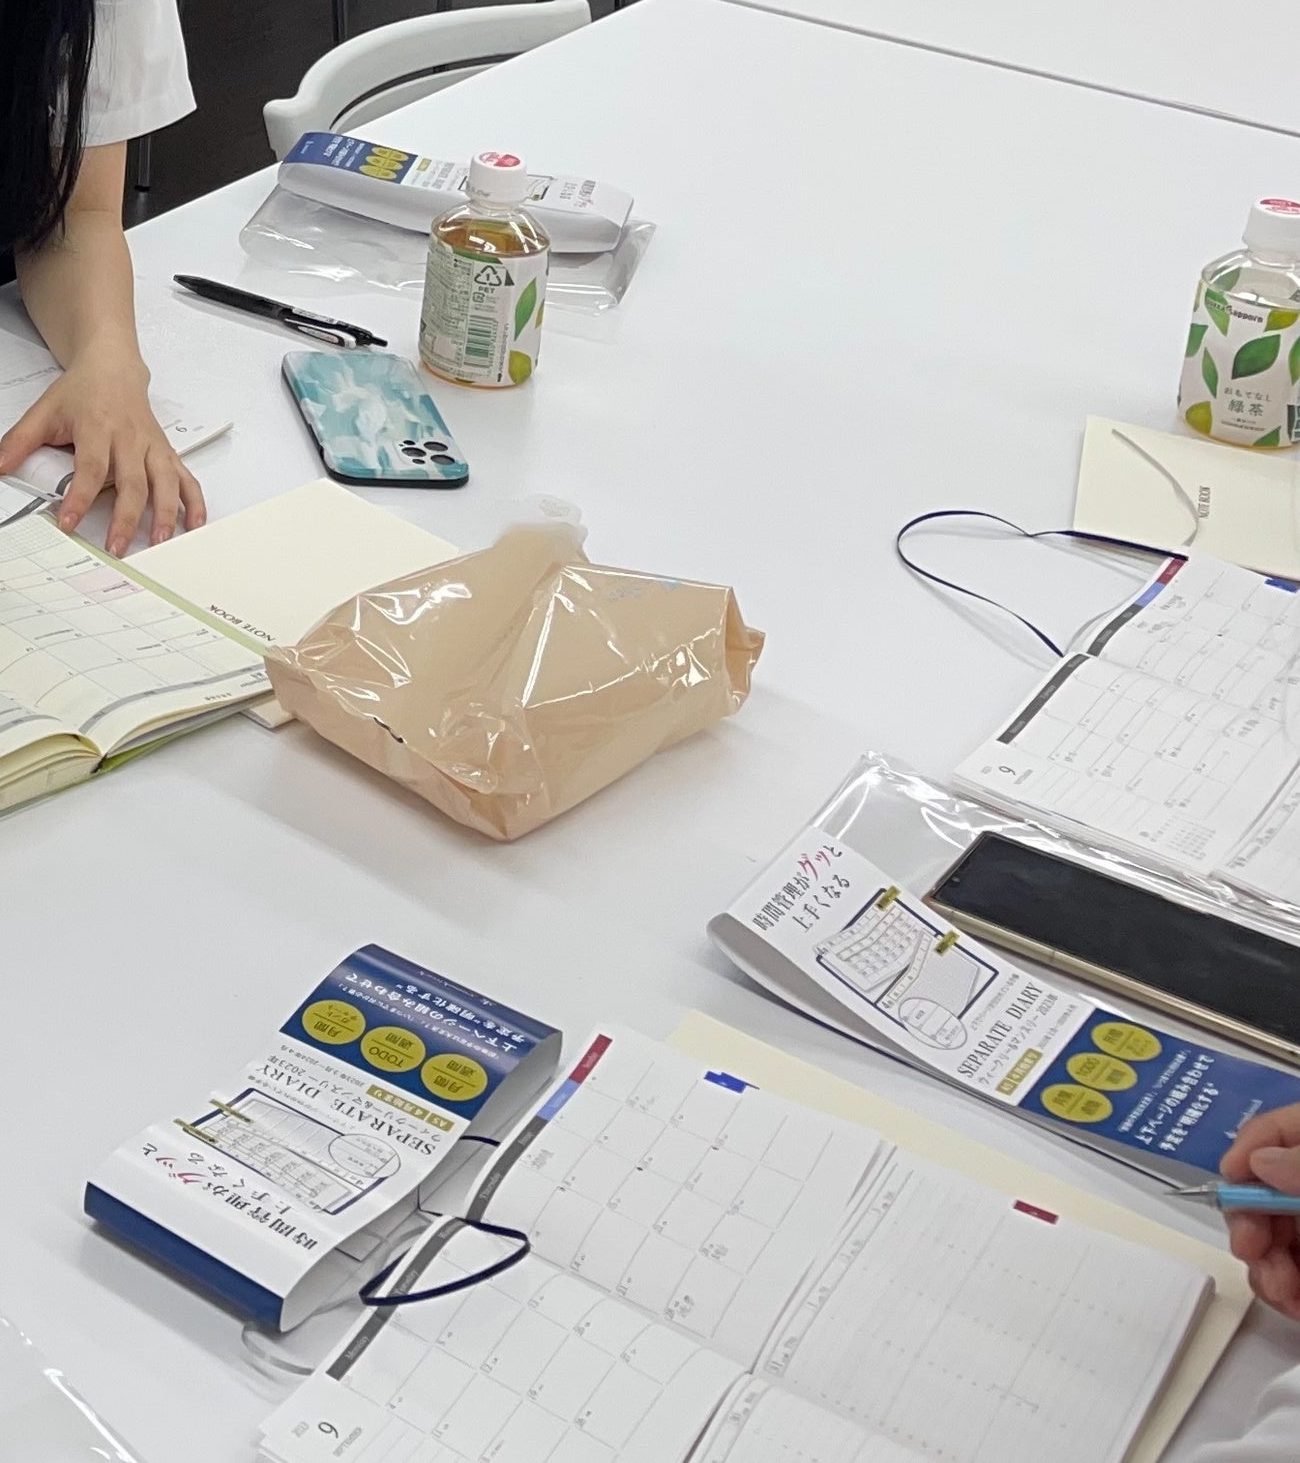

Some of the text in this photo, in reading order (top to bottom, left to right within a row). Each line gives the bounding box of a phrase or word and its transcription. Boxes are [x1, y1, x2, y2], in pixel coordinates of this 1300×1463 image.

[1228, 399, 1264, 416] 緑茶
[209, 604, 275, 641] NOTE BOOK
[793, 875, 851, 933] 上手くなる
[313, 1020, 342, 1038] 月間
[957, 1022, 1013, 1078] SEPARATE
[1005, 982, 1043, 1023] DIARY
[369, 1045, 404, 1068] TODO
[259, 1063, 319, 1098] DIARY
[432, 1075, 460, 1094] 月間
[331, 1098, 437, 1156] SEPARATE
[142, 1142, 318, 1251] 時間管理がグッと
[317, 1420, 339, 1440] 9
